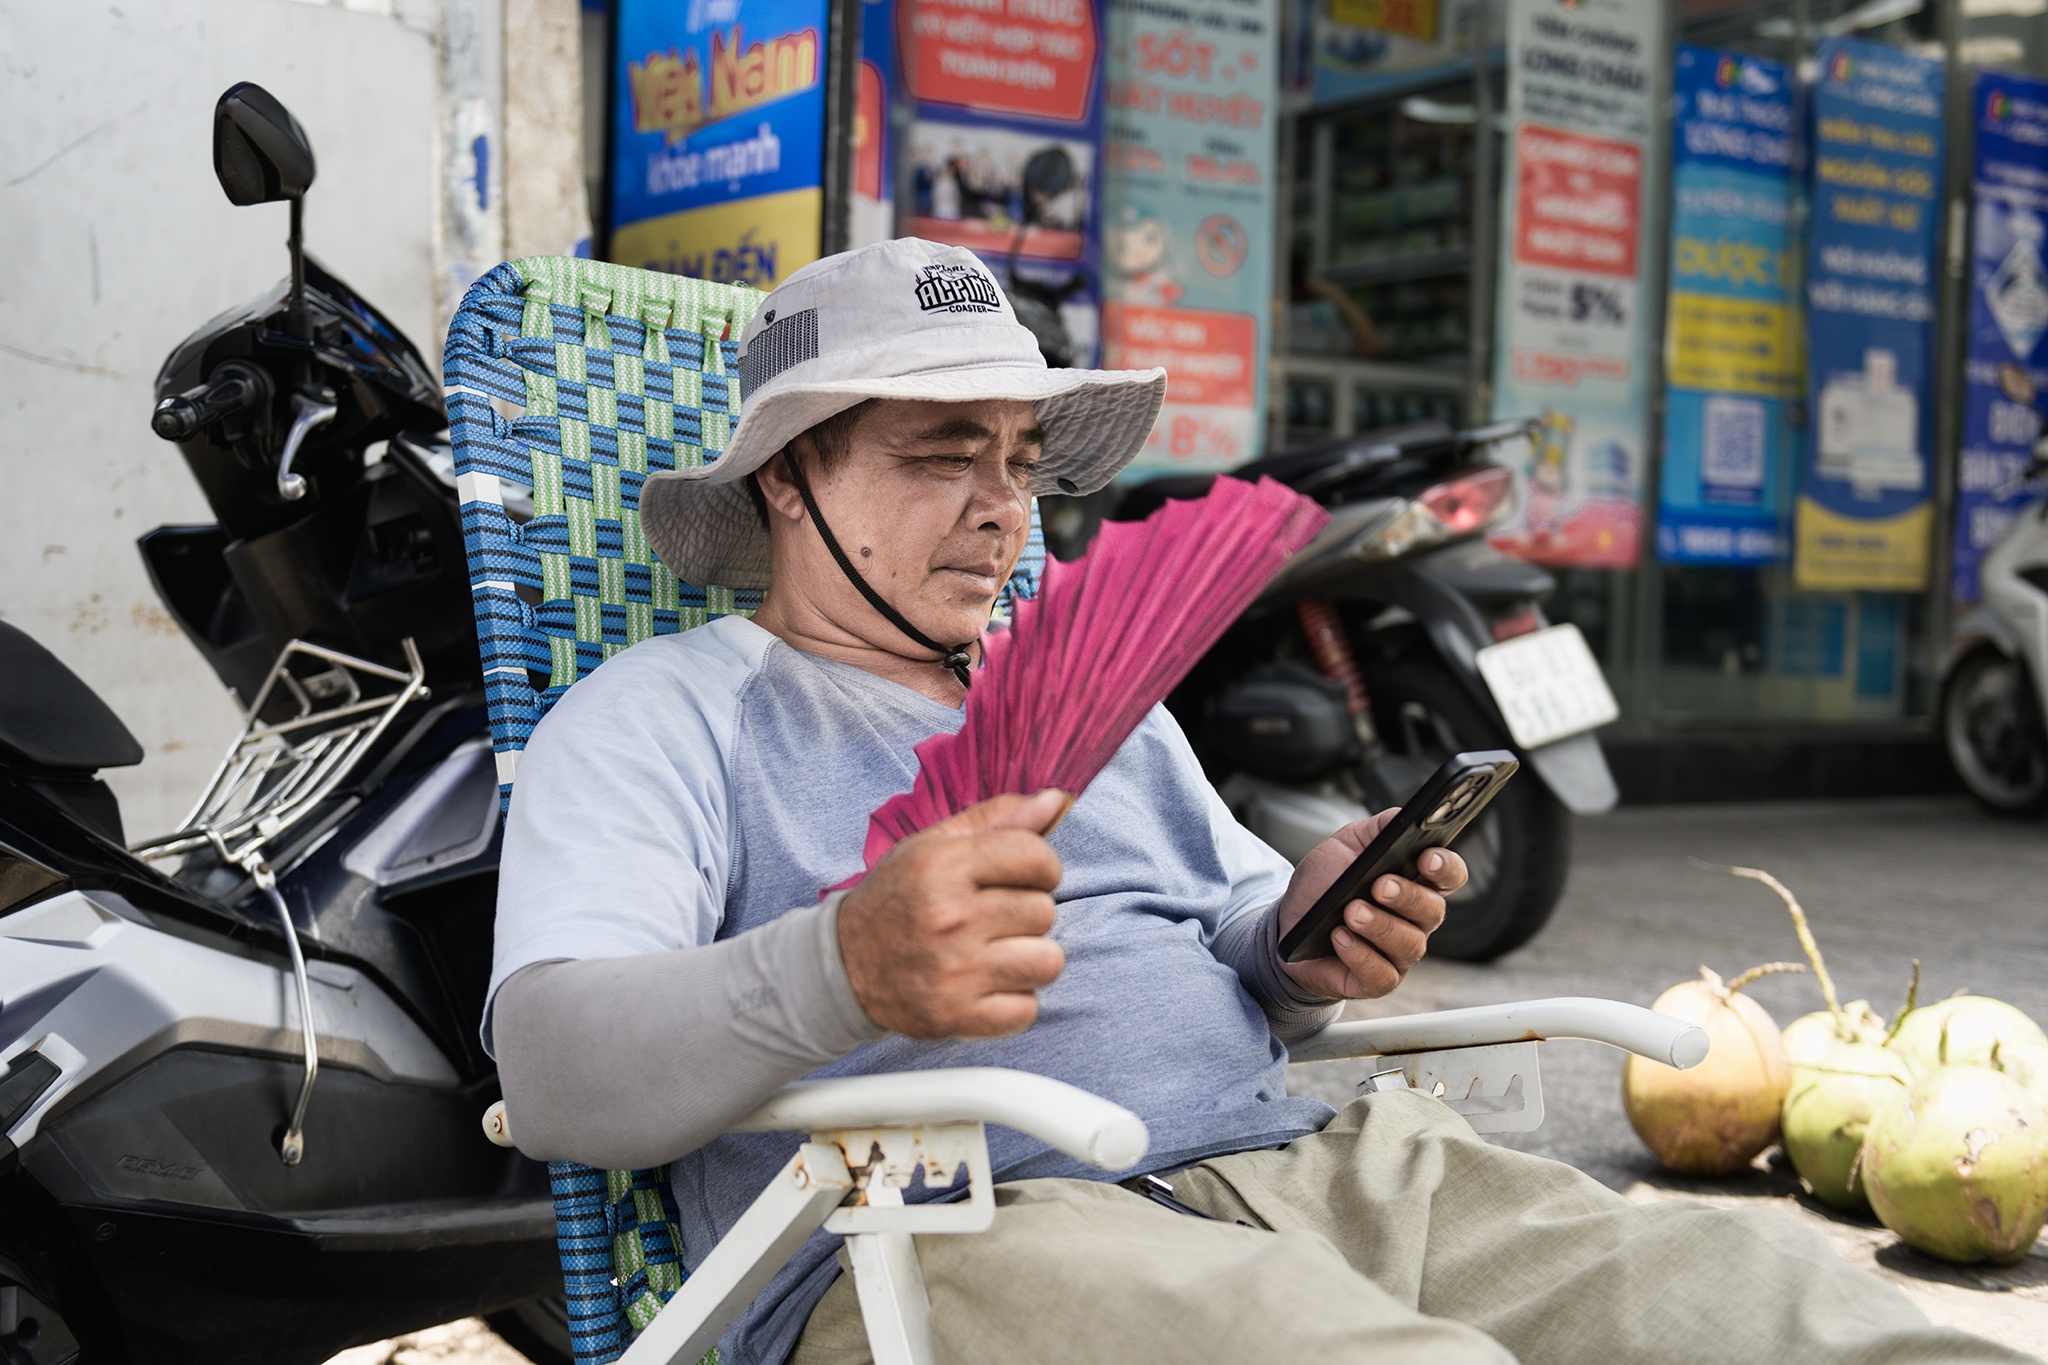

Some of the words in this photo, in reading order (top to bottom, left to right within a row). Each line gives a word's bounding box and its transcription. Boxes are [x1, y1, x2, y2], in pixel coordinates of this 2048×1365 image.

[707, 26, 818, 118] Nam
[1136, 26, 1219, 82] SỐT
[915, 276, 1000, 310] ALPINE
[948, 304, 988, 314] COASTER
